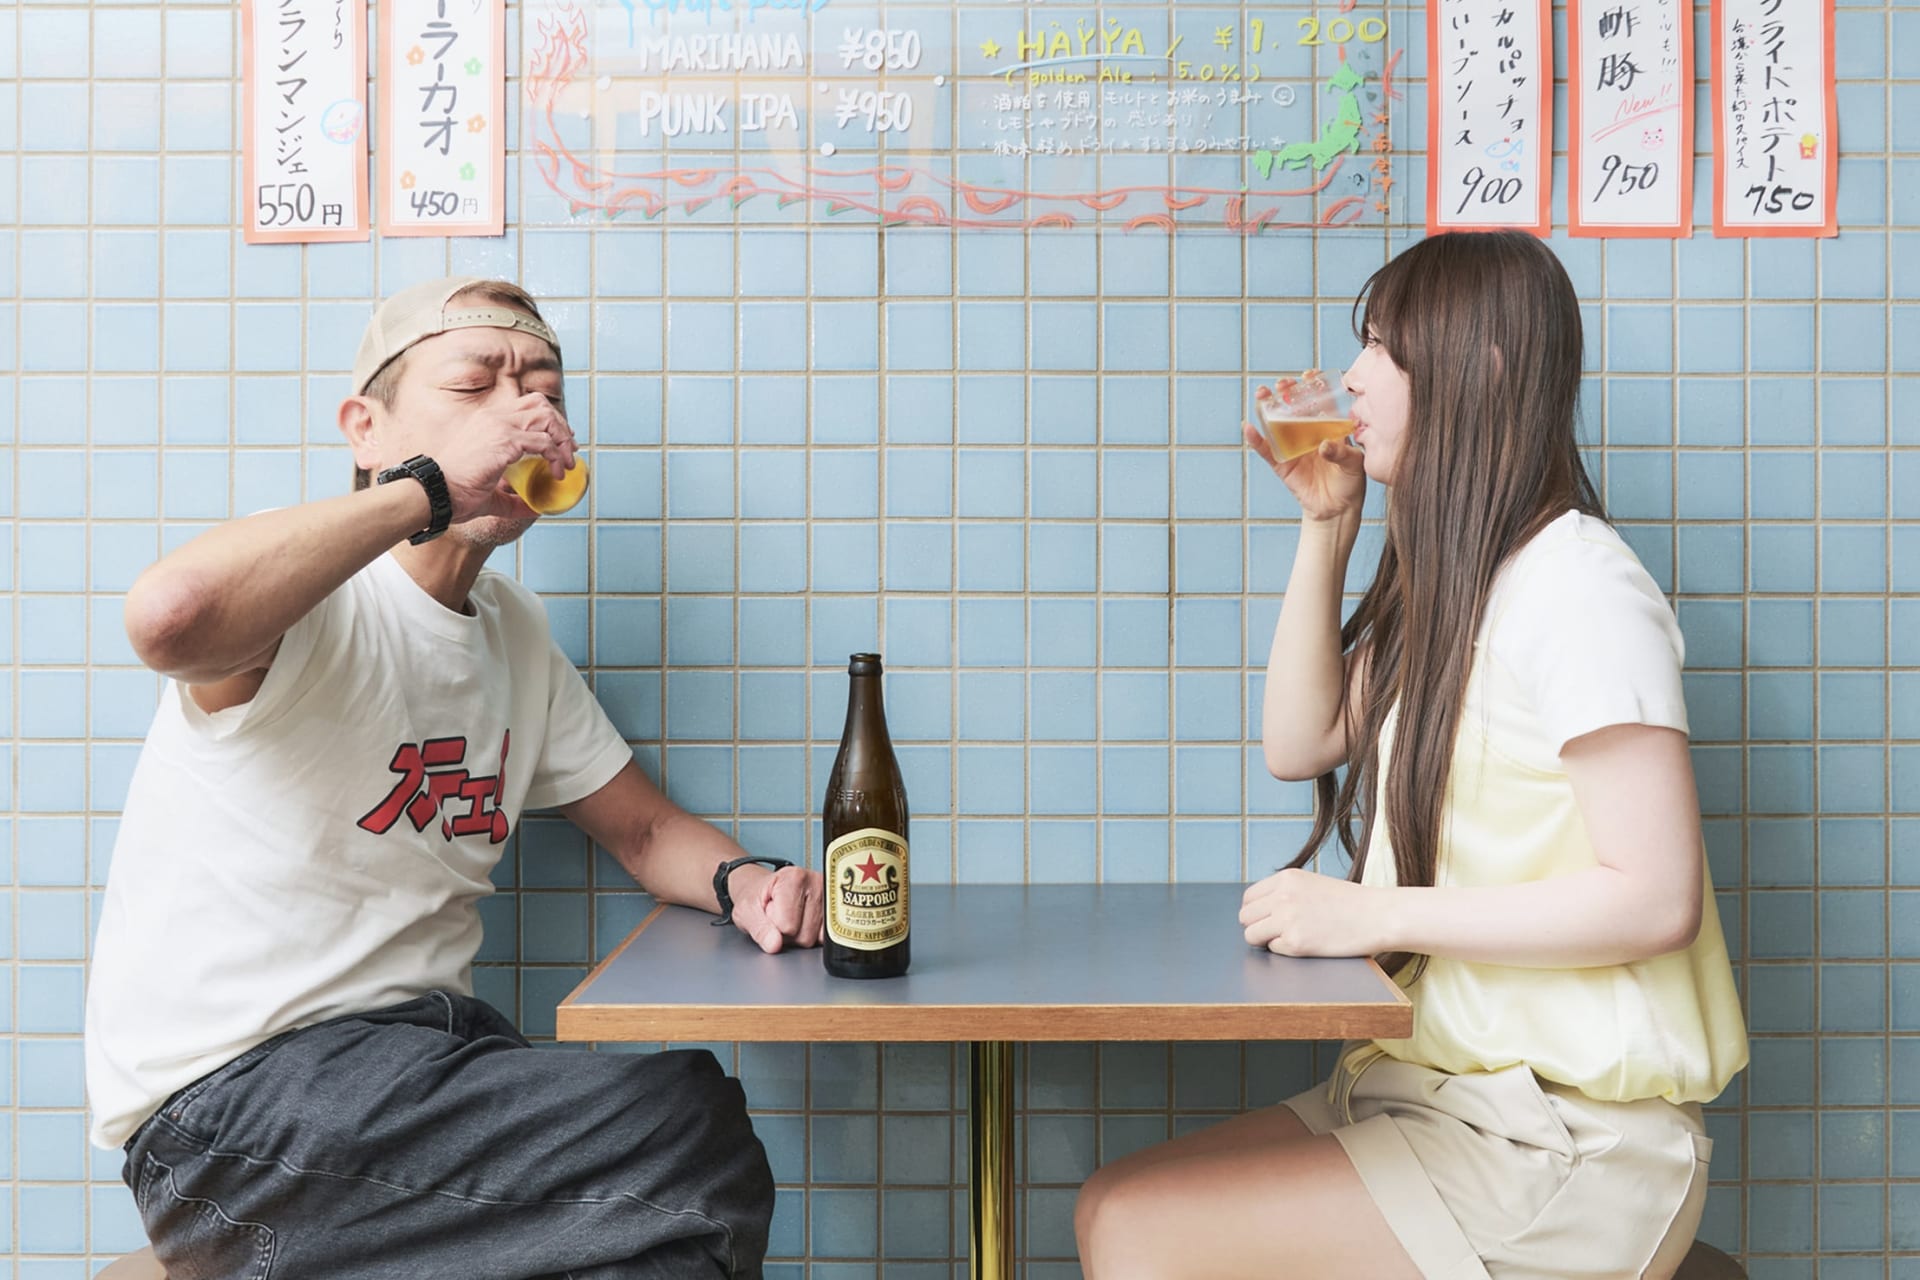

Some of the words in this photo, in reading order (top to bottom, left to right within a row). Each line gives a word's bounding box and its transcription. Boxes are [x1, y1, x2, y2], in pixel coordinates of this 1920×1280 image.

[639, 33, 803, 71] MARIHANA
[839, 28, 922, 71] ¥850
[1597, 6, 1648, 92] 酢豚
[1099, 68, 1132, 84] Ale
[639, 91, 727, 137] PUNK
[740, 92, 799, 132] IPA
[835, 89, 913, 132] ¥950
[1456, 167, 1523, 214] 900
[1592, 154, 1659, 202] 950
[259, 183, 343, 226] 550円
[410, 191, 478, 218] 450円
[1745, 184, 1815, 216] 750
[843, 890, 897, 907] SAPPORO
[845, 908, 874, 919] LAGER
[875, 907, 897, 917] BEER
